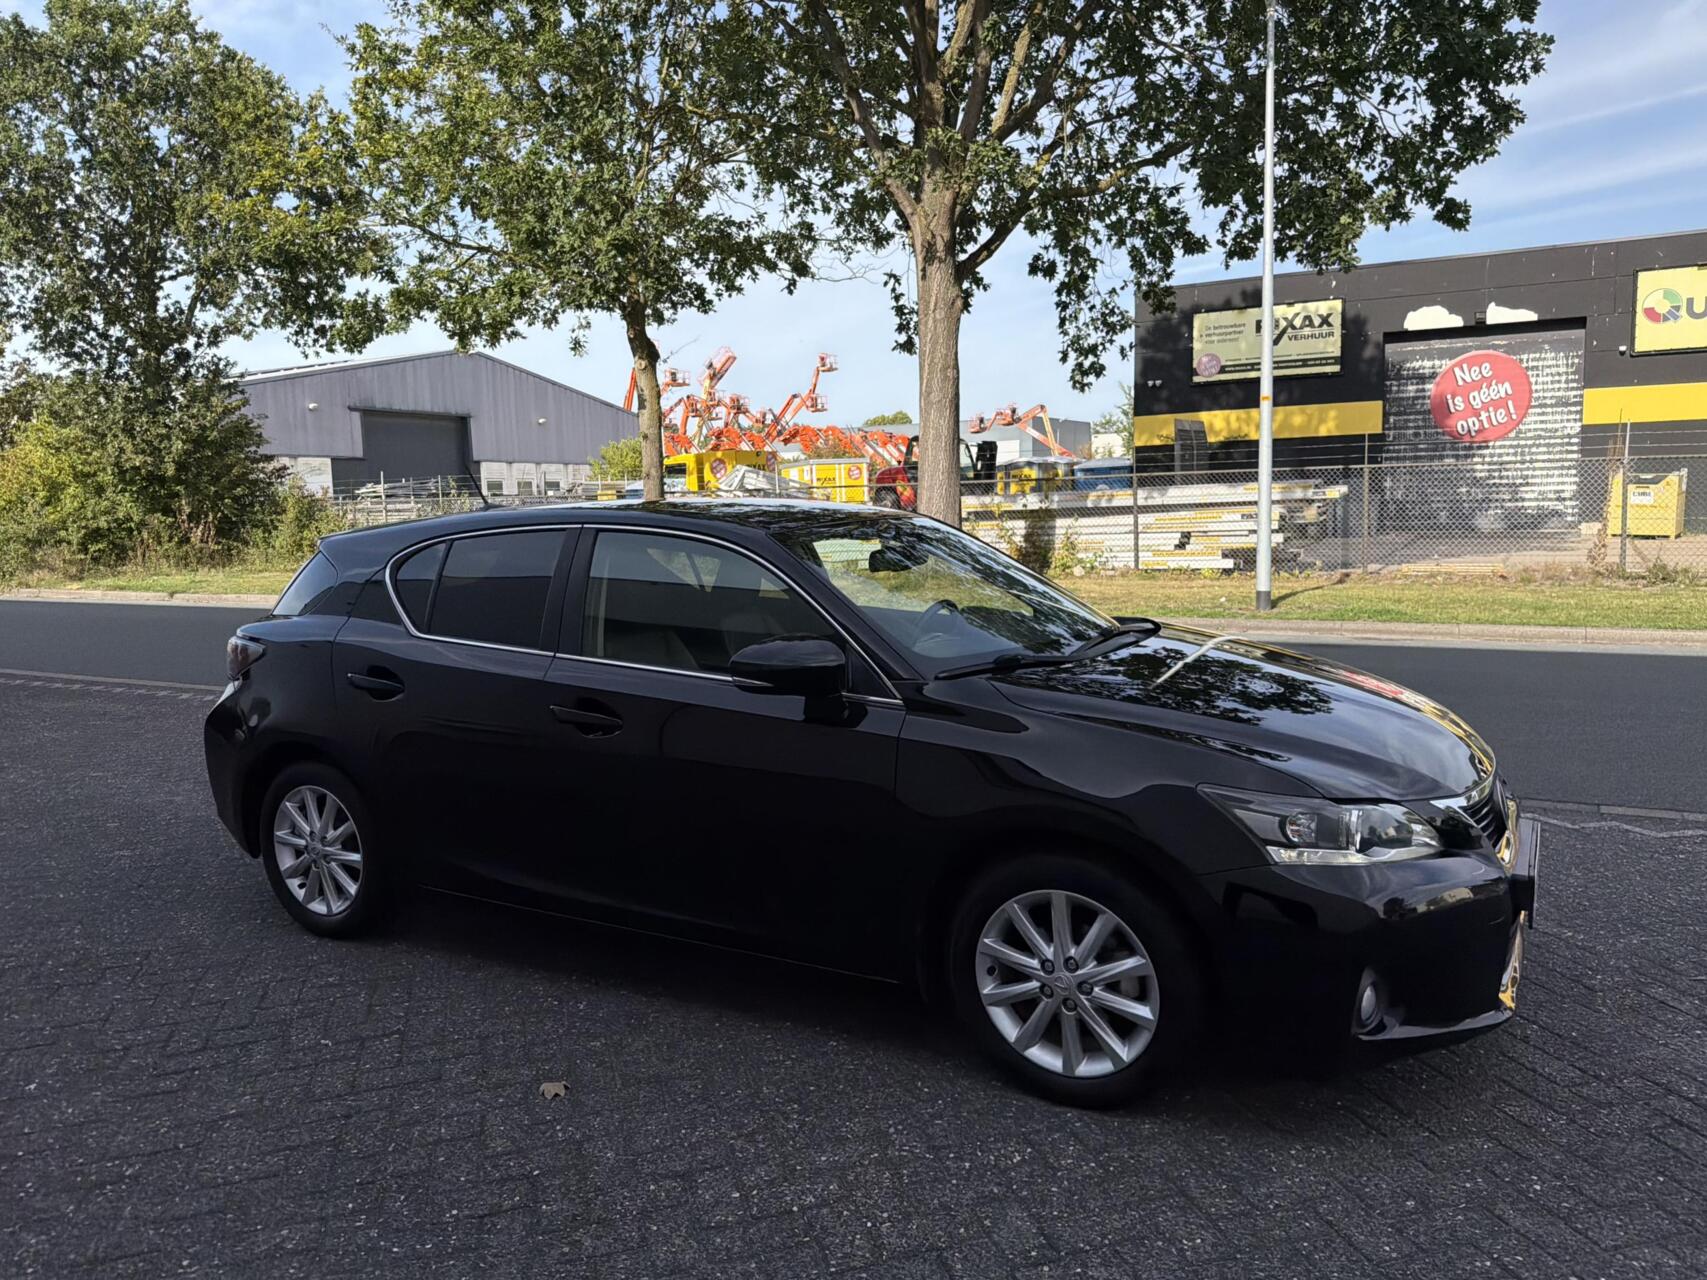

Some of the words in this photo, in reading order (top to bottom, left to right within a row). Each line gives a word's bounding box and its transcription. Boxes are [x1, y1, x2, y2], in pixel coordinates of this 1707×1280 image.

[1288, 331, 1335, 341] VERHUUR
[1453, 362, 1493, 386] Nee
[1446, 394, 1465, 414] is
[1469, 379, 1513, 409] géén
